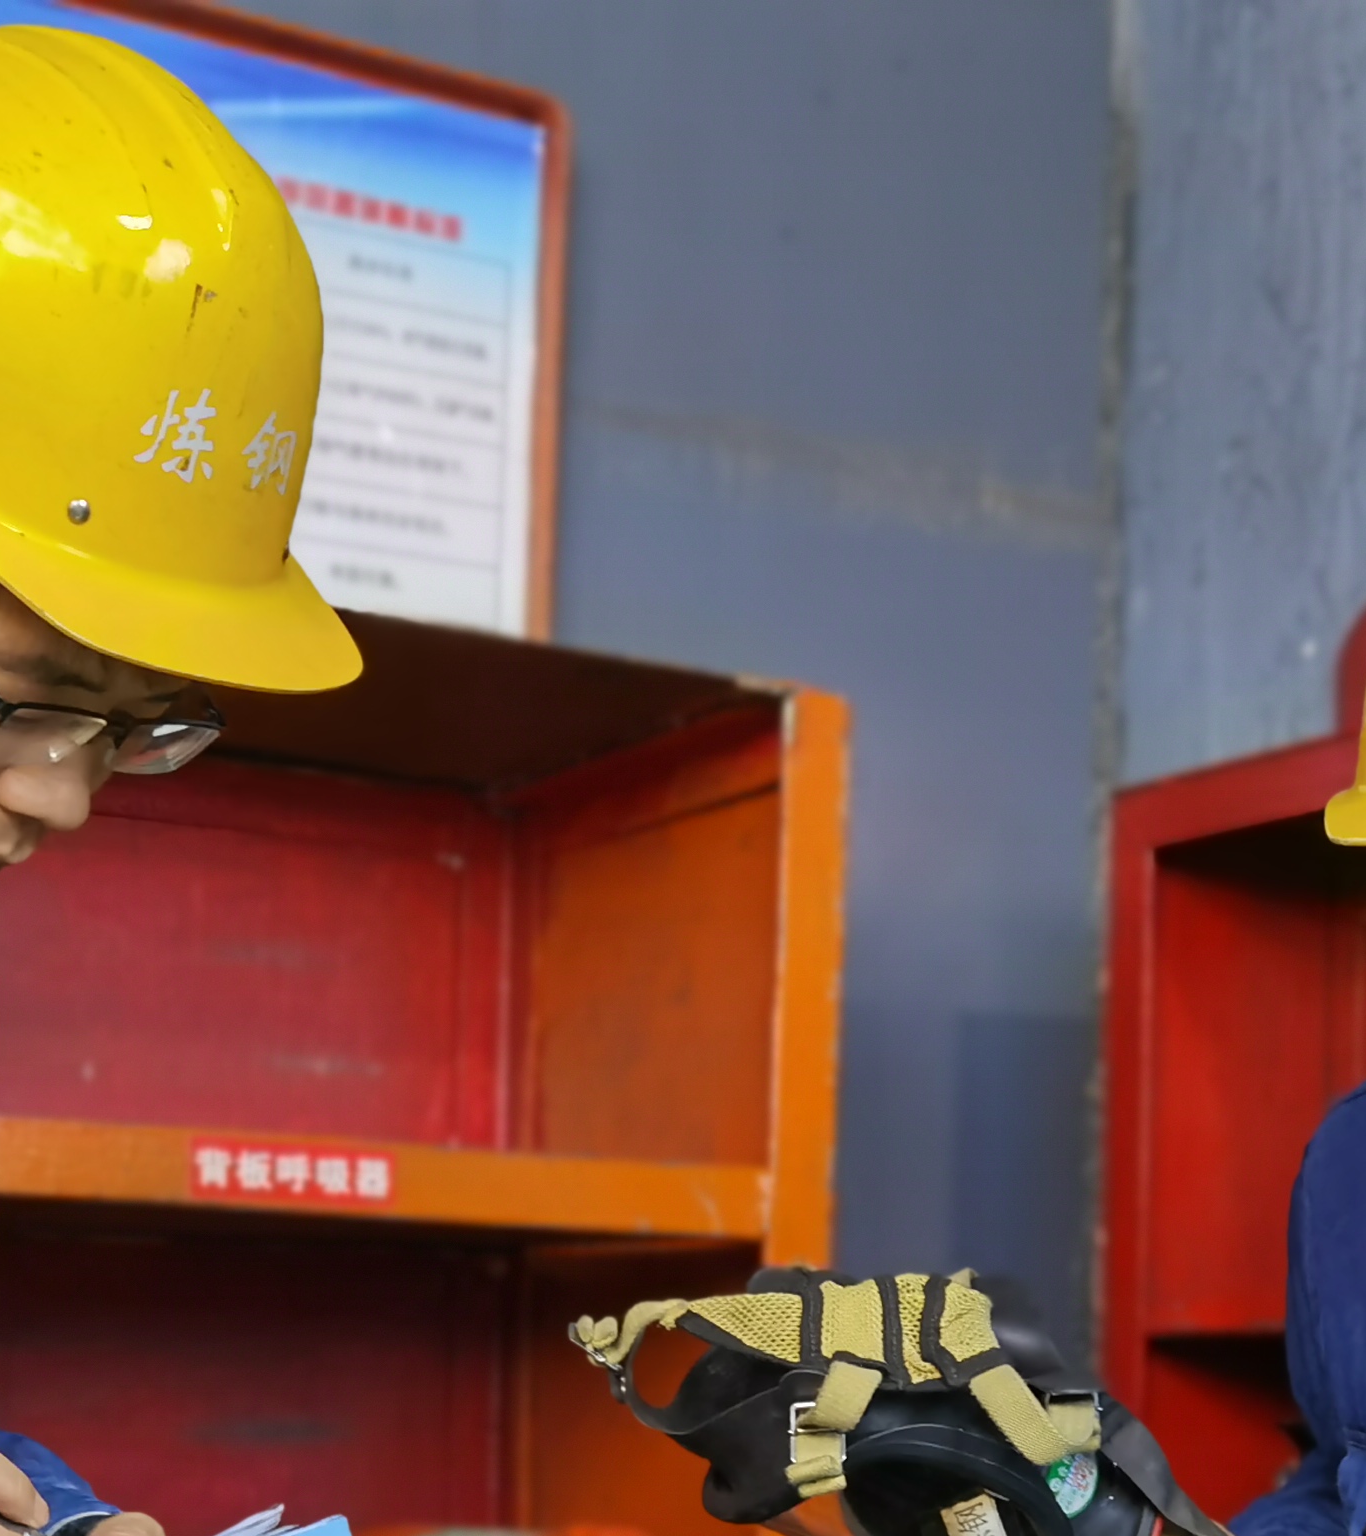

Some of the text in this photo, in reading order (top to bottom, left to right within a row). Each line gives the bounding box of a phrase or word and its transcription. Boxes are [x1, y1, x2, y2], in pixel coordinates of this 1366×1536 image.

[133, 388, 297, 496] 炼钢
[194, 1145, 389, 1198] 背板呼吸器
